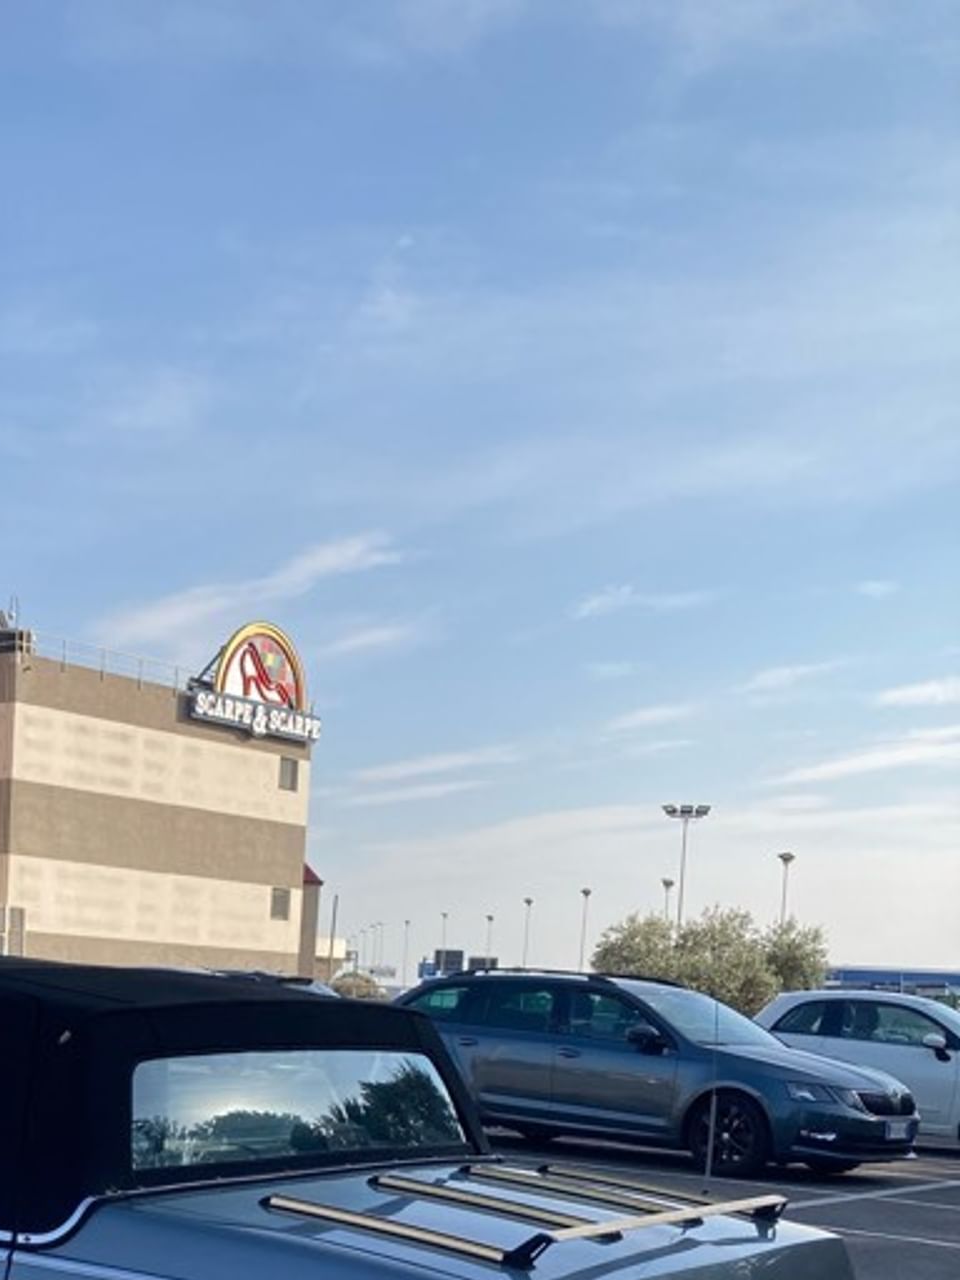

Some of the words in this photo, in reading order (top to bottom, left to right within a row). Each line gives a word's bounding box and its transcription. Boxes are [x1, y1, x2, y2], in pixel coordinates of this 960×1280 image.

[194, 692, 252, 724] SCARPE
[252, 704, 267, 734] &
[269, 709, 321, 739] SCARPE
